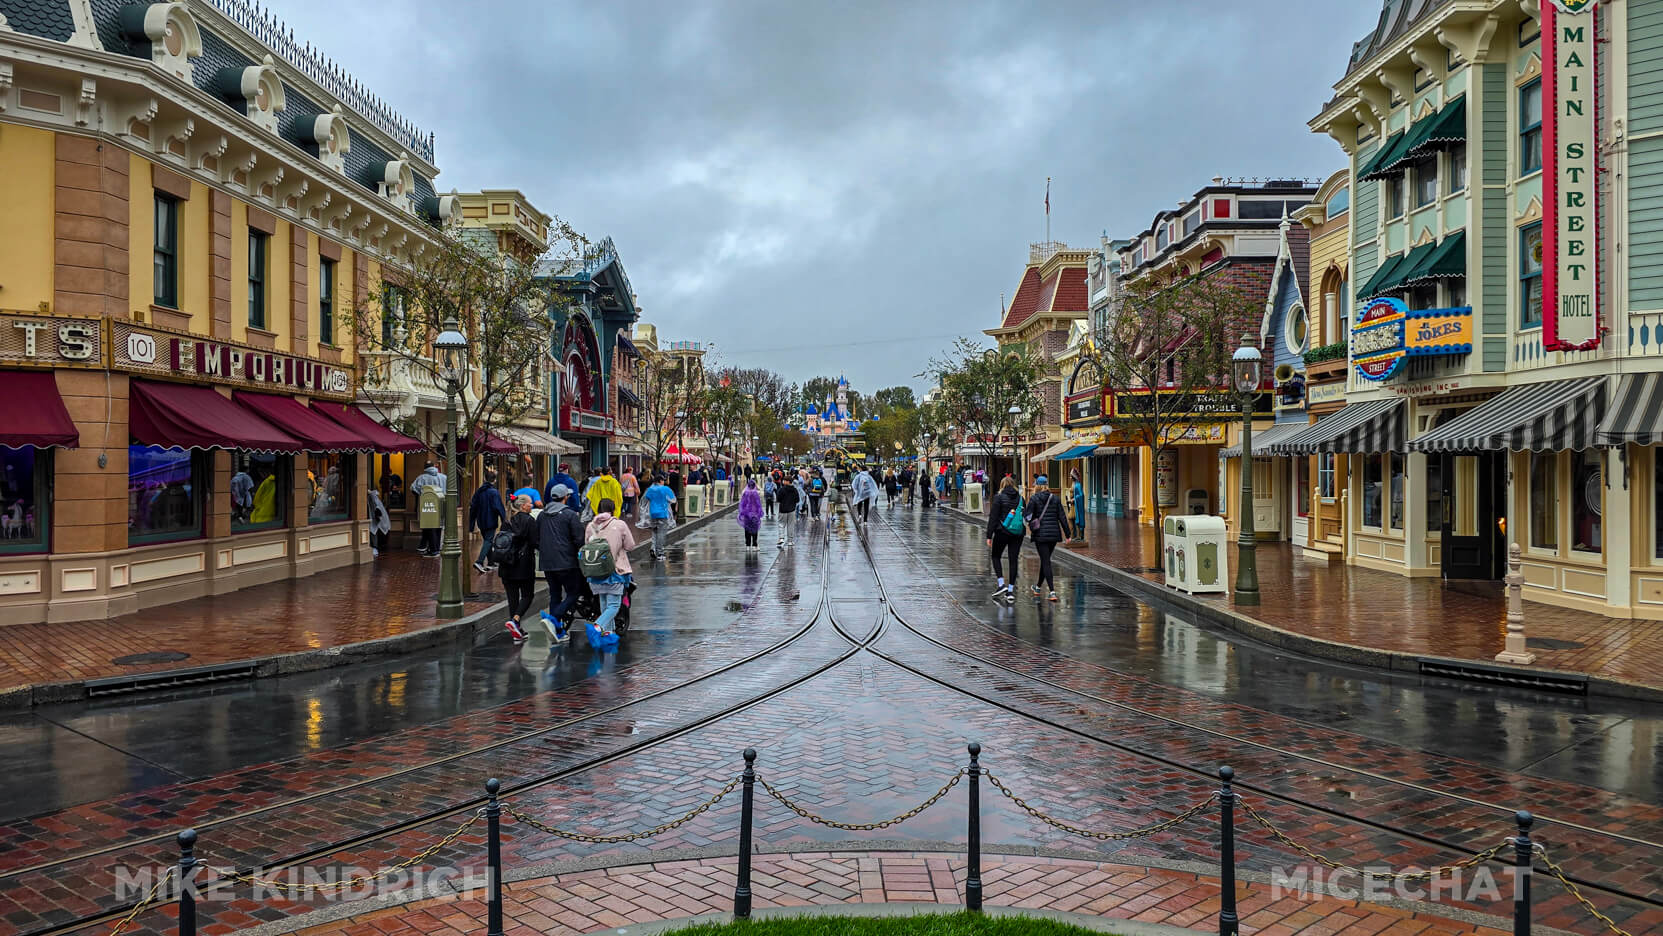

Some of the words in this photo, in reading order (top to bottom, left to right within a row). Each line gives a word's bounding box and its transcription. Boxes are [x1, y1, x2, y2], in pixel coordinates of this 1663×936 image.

[1564, 26, 1585, 116] MAIN
[1566, 142, 1586, 281] STREET
[1371, 307, 1386, 318] MAIN
[1562, 295, 1592, 317] HOTEL
[1415, 321, 1462, 342] JOKES
[131, 339, 153, 357] 101
[178, 338, 334, 391] EMPORIUM
[1368, 362, 1386, 373] STREET
